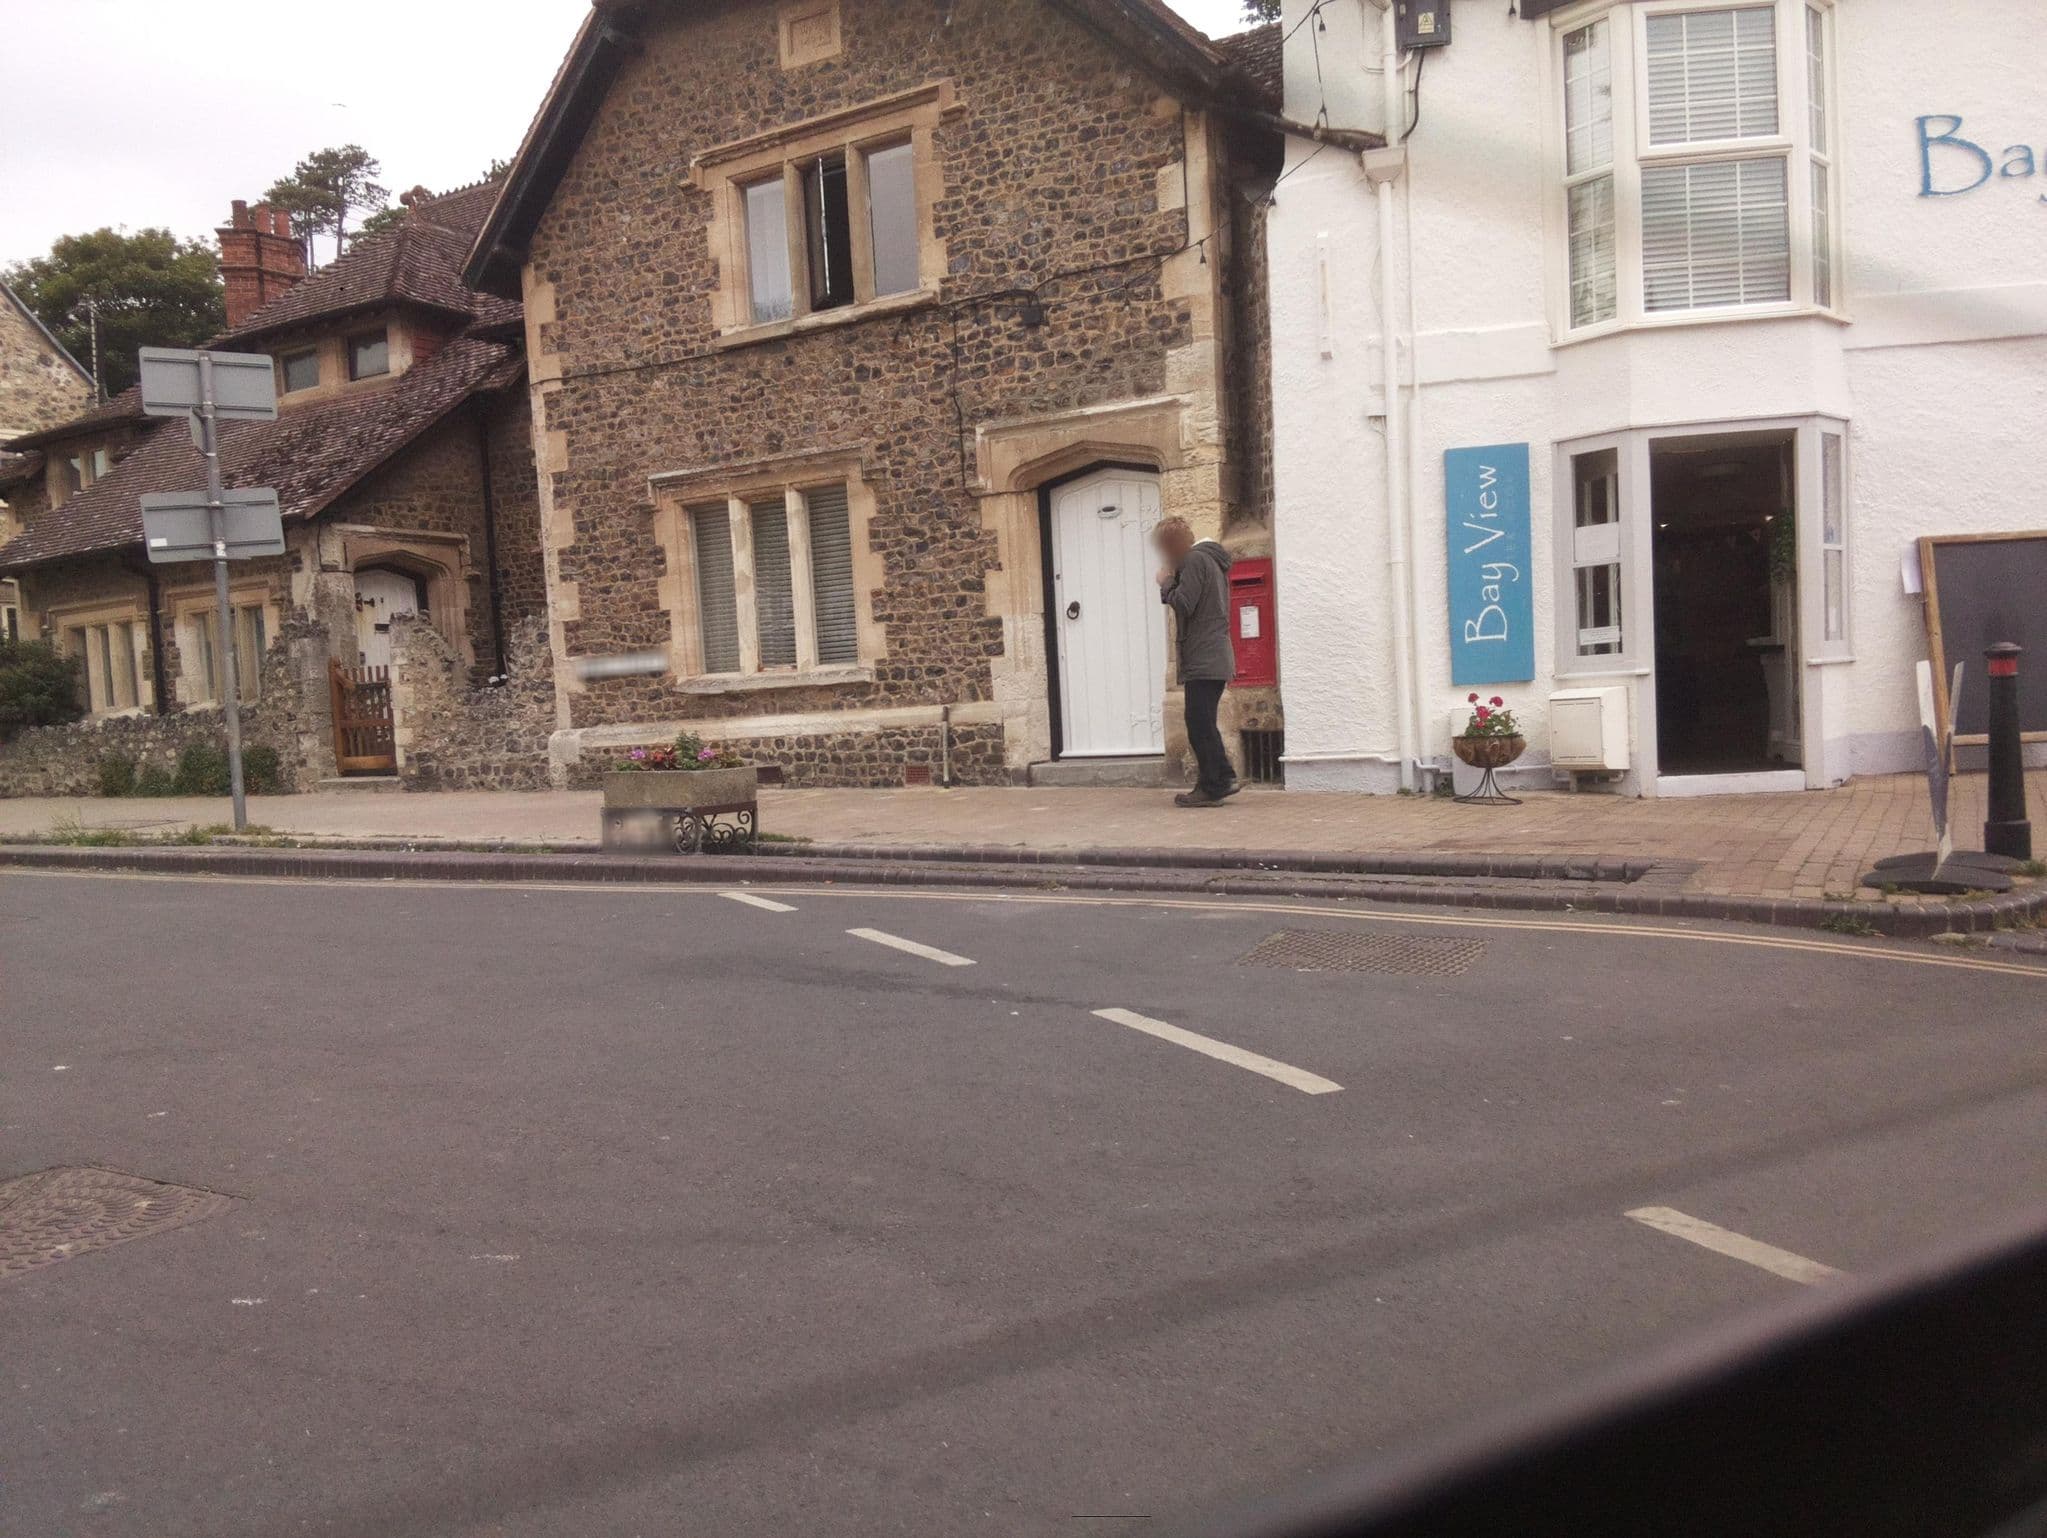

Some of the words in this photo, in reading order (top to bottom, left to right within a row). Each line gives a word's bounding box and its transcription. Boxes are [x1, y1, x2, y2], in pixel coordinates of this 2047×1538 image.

[1914, 114, 2047, 202] Ba
[1462, 465, 1505, 554] View
[1464, 562, 1519, 643] Bay
